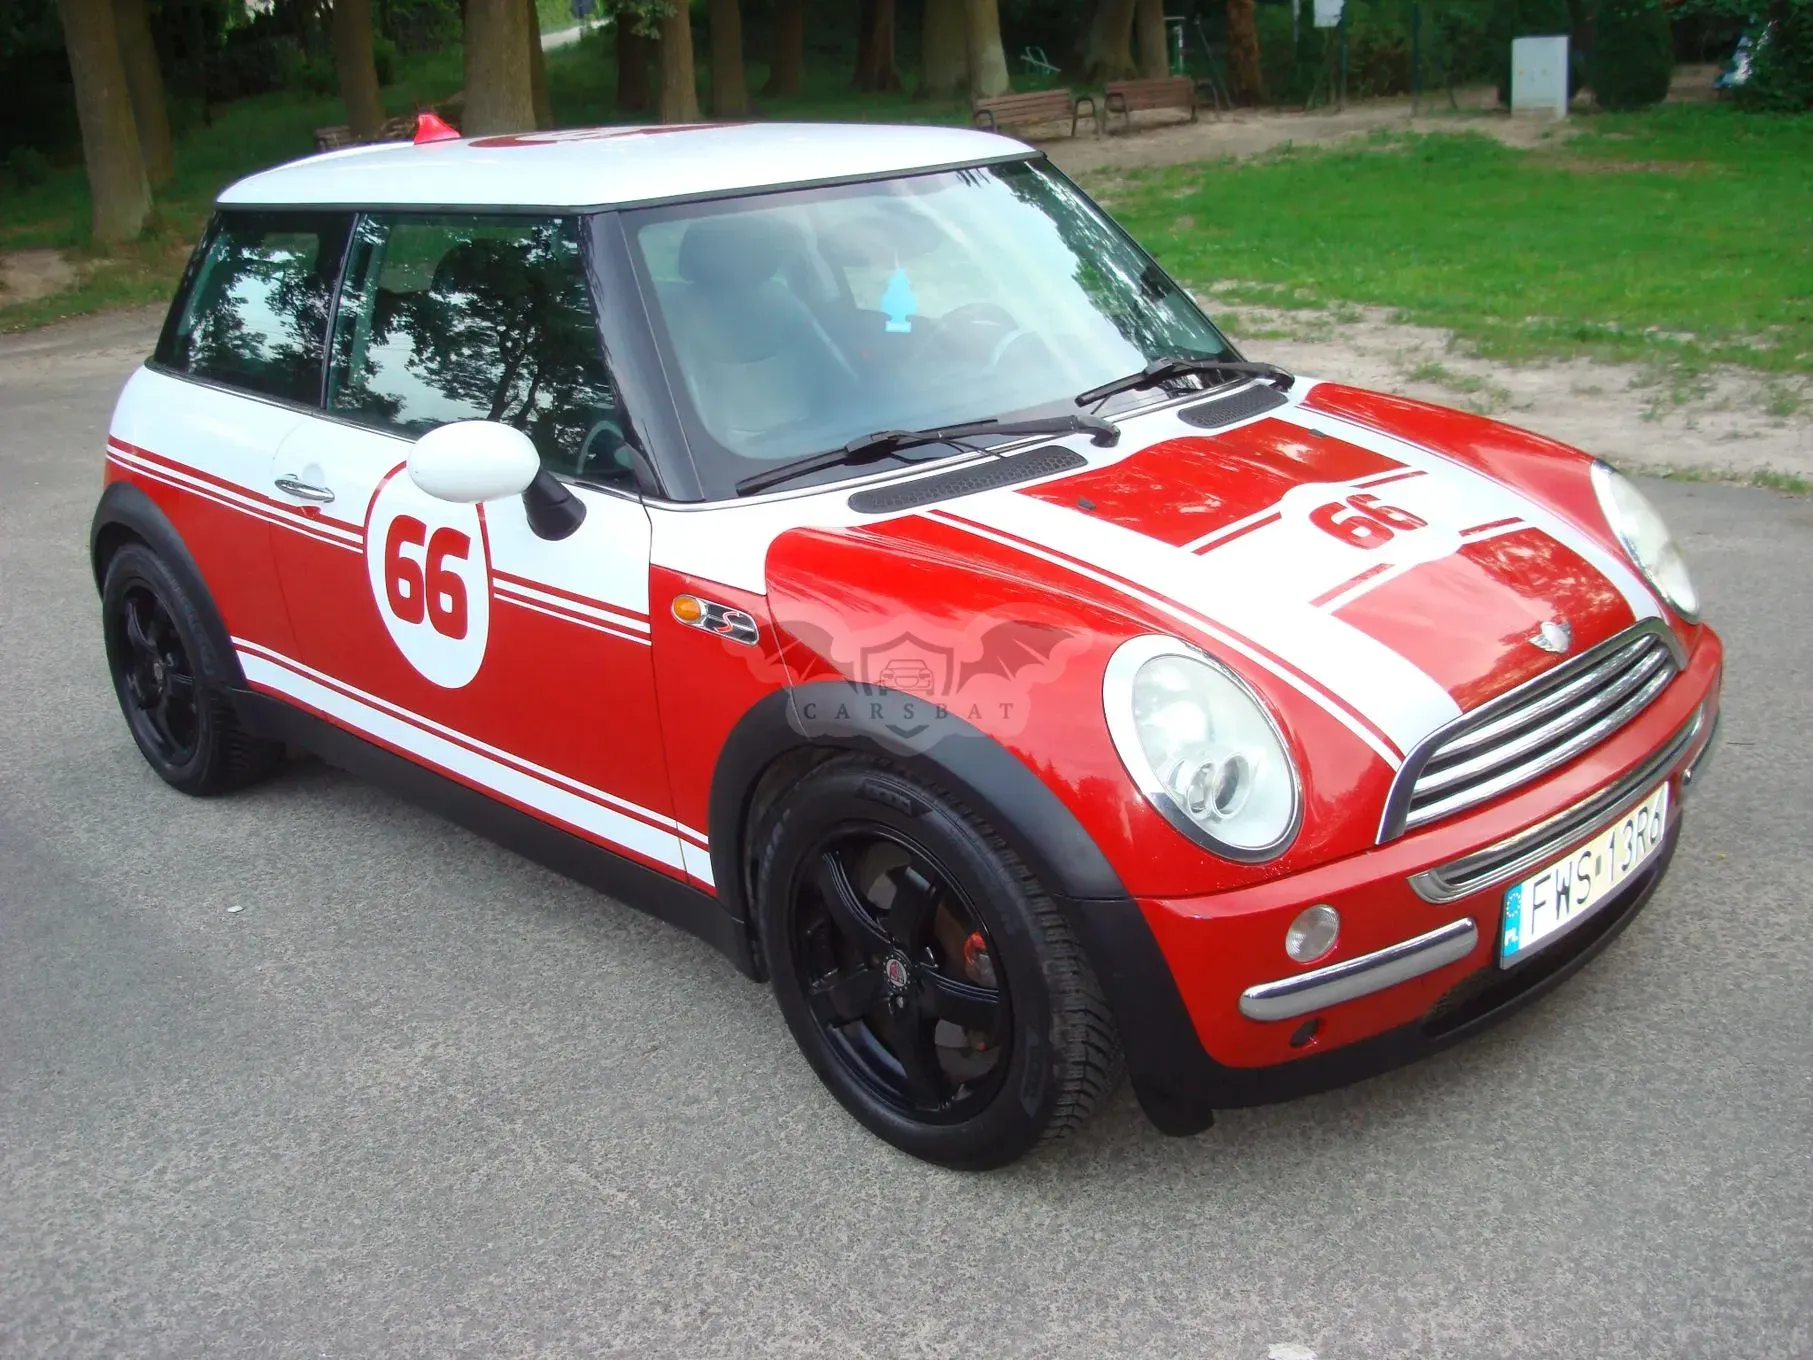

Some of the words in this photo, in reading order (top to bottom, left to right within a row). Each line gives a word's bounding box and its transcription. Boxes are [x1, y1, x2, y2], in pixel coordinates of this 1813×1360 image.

[1308, 493, 1429, 551] 66
[384, 514, 471, 640] 66
[1531, 850, 1593, 936] FWS
[1608, 790, 1662, 882] 13R6
[1504, 927, 1519, 947] PL
